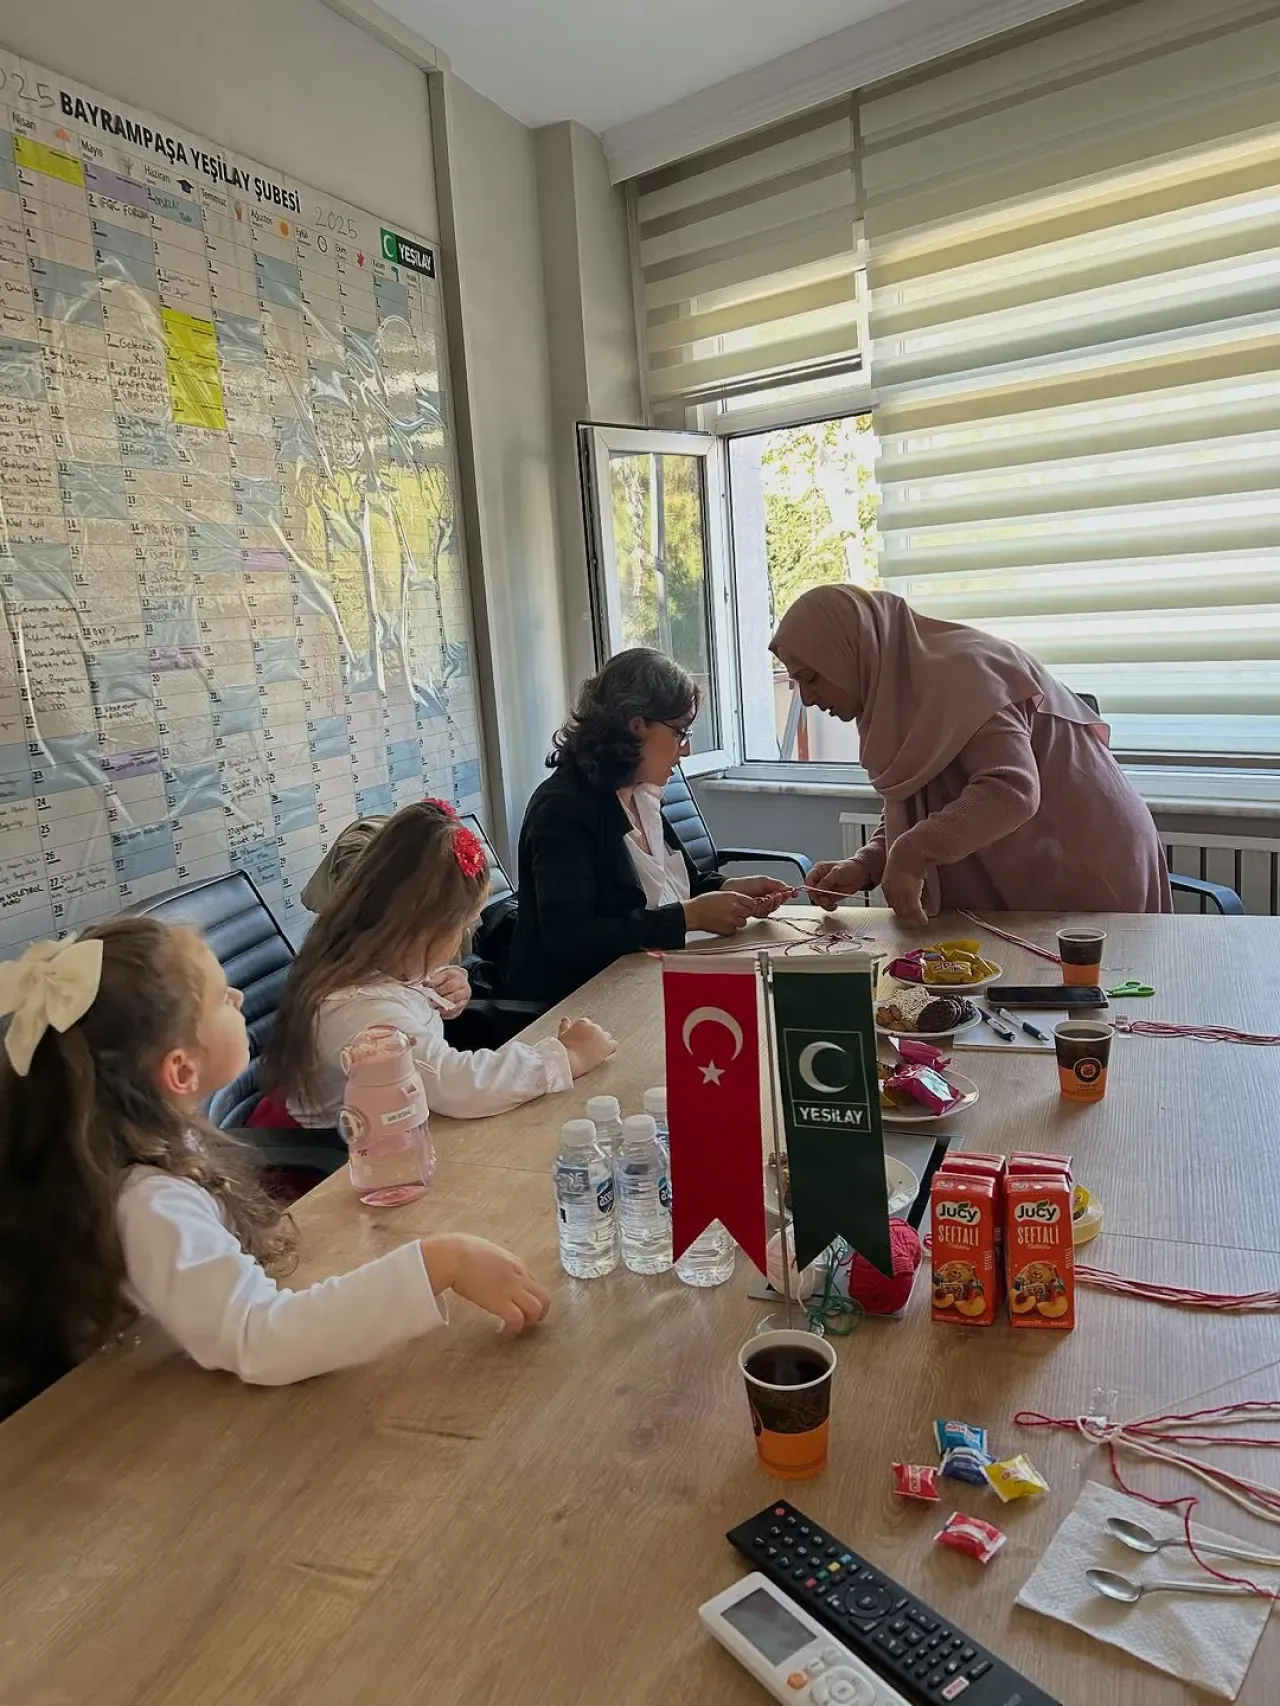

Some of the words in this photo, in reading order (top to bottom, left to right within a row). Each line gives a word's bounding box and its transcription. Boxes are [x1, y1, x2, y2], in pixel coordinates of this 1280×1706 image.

[60, 89, 188, 165] BAYRAMPAŞA
[190, 146, 250, 192] YEŞİLAY
[254, 177, 301, 213] ŞUBESİ
[314, 206, 358, 239] 2025
[939, 1203, 978, 1222] Jucy
[1017, 1204, 1057, 1222] Jucy
